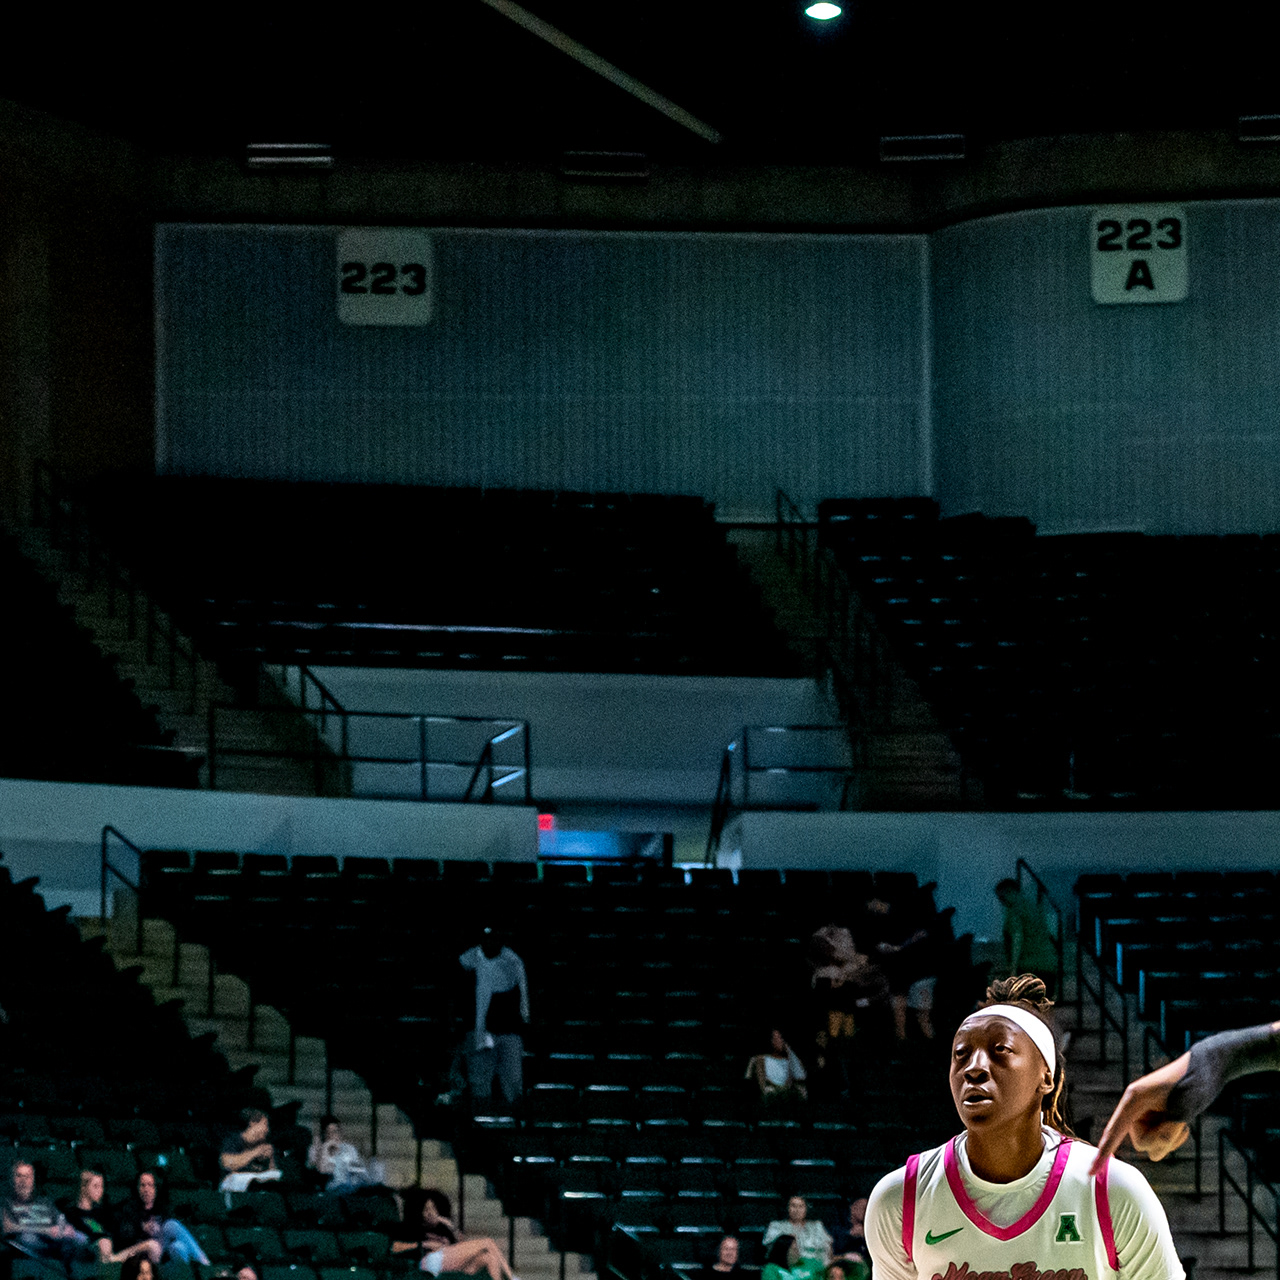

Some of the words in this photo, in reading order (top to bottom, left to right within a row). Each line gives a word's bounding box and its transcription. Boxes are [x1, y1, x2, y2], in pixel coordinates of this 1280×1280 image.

[1097, 218, 1182, 252] 223
[341, 262, 427, 296] 223
[1125, 260, 1155, 291] A
